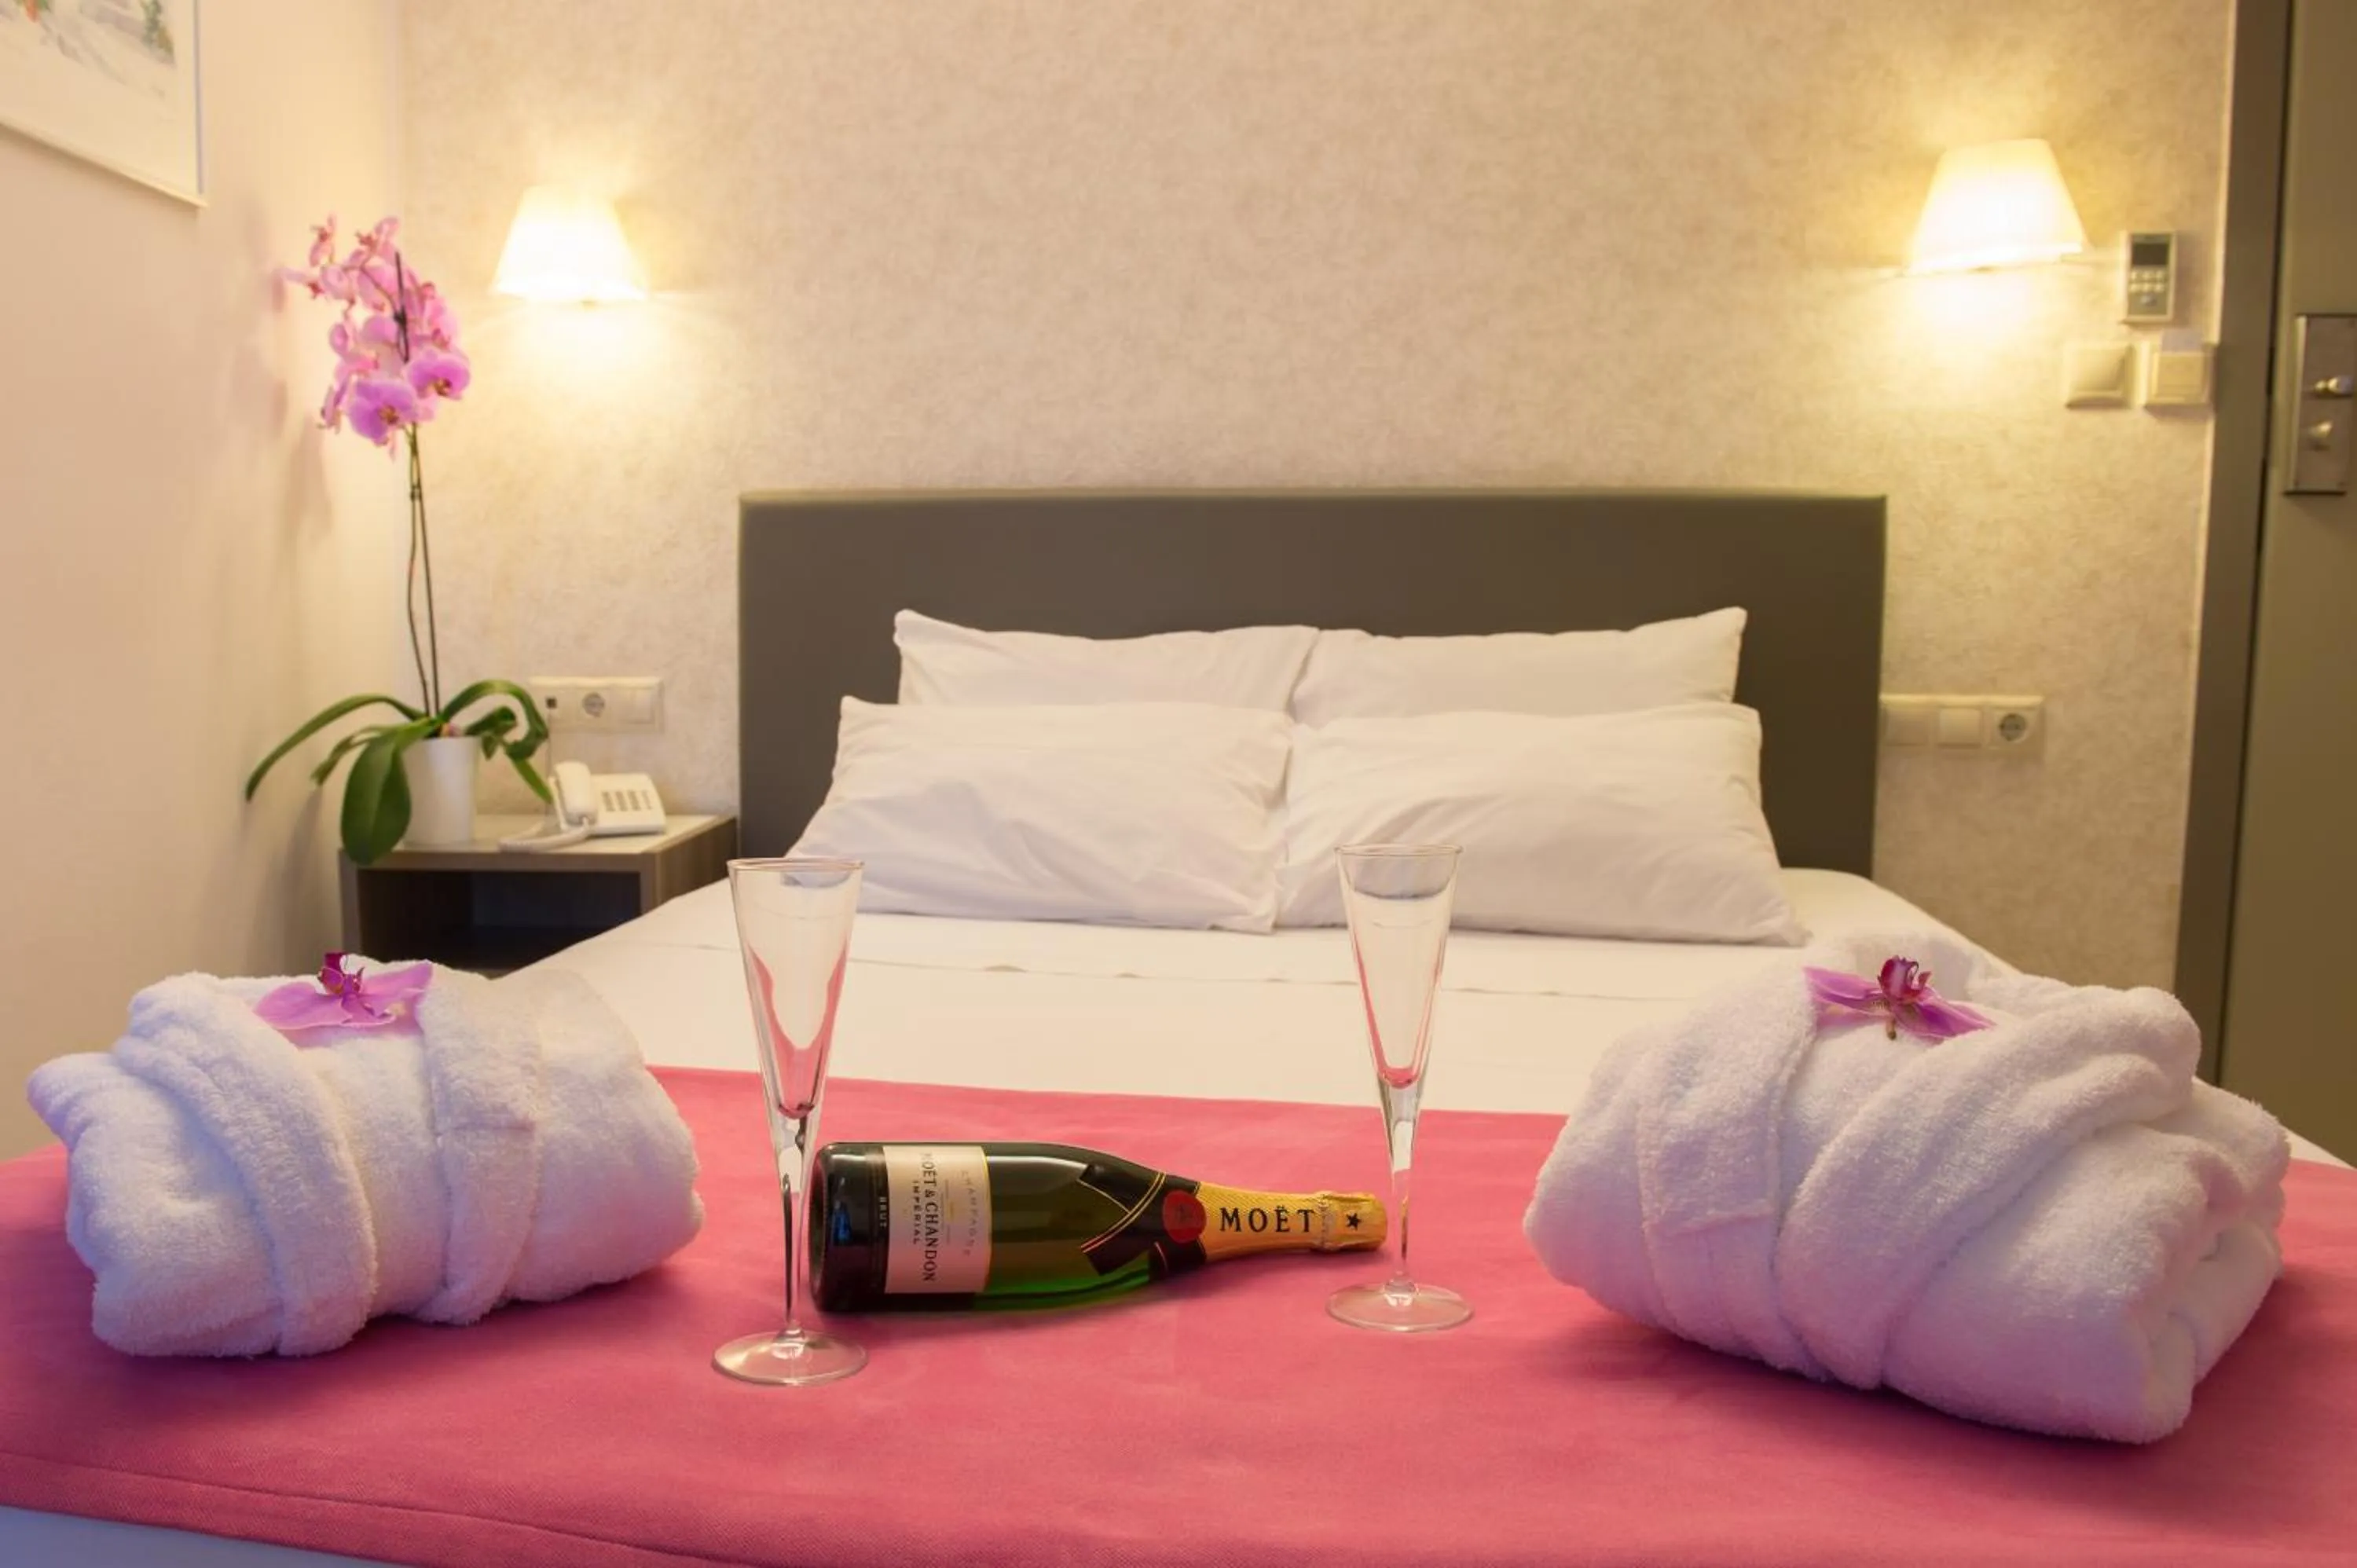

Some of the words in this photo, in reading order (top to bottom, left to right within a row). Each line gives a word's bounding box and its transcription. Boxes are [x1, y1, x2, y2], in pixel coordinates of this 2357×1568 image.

[912, 1180, 922, 1245] IMPÉRIAL
[925, 1189, 936, 1198] &
[922, 1201, 940, 1282] CHANDON
[1219, 1205, 1314, 1233] MOËT
